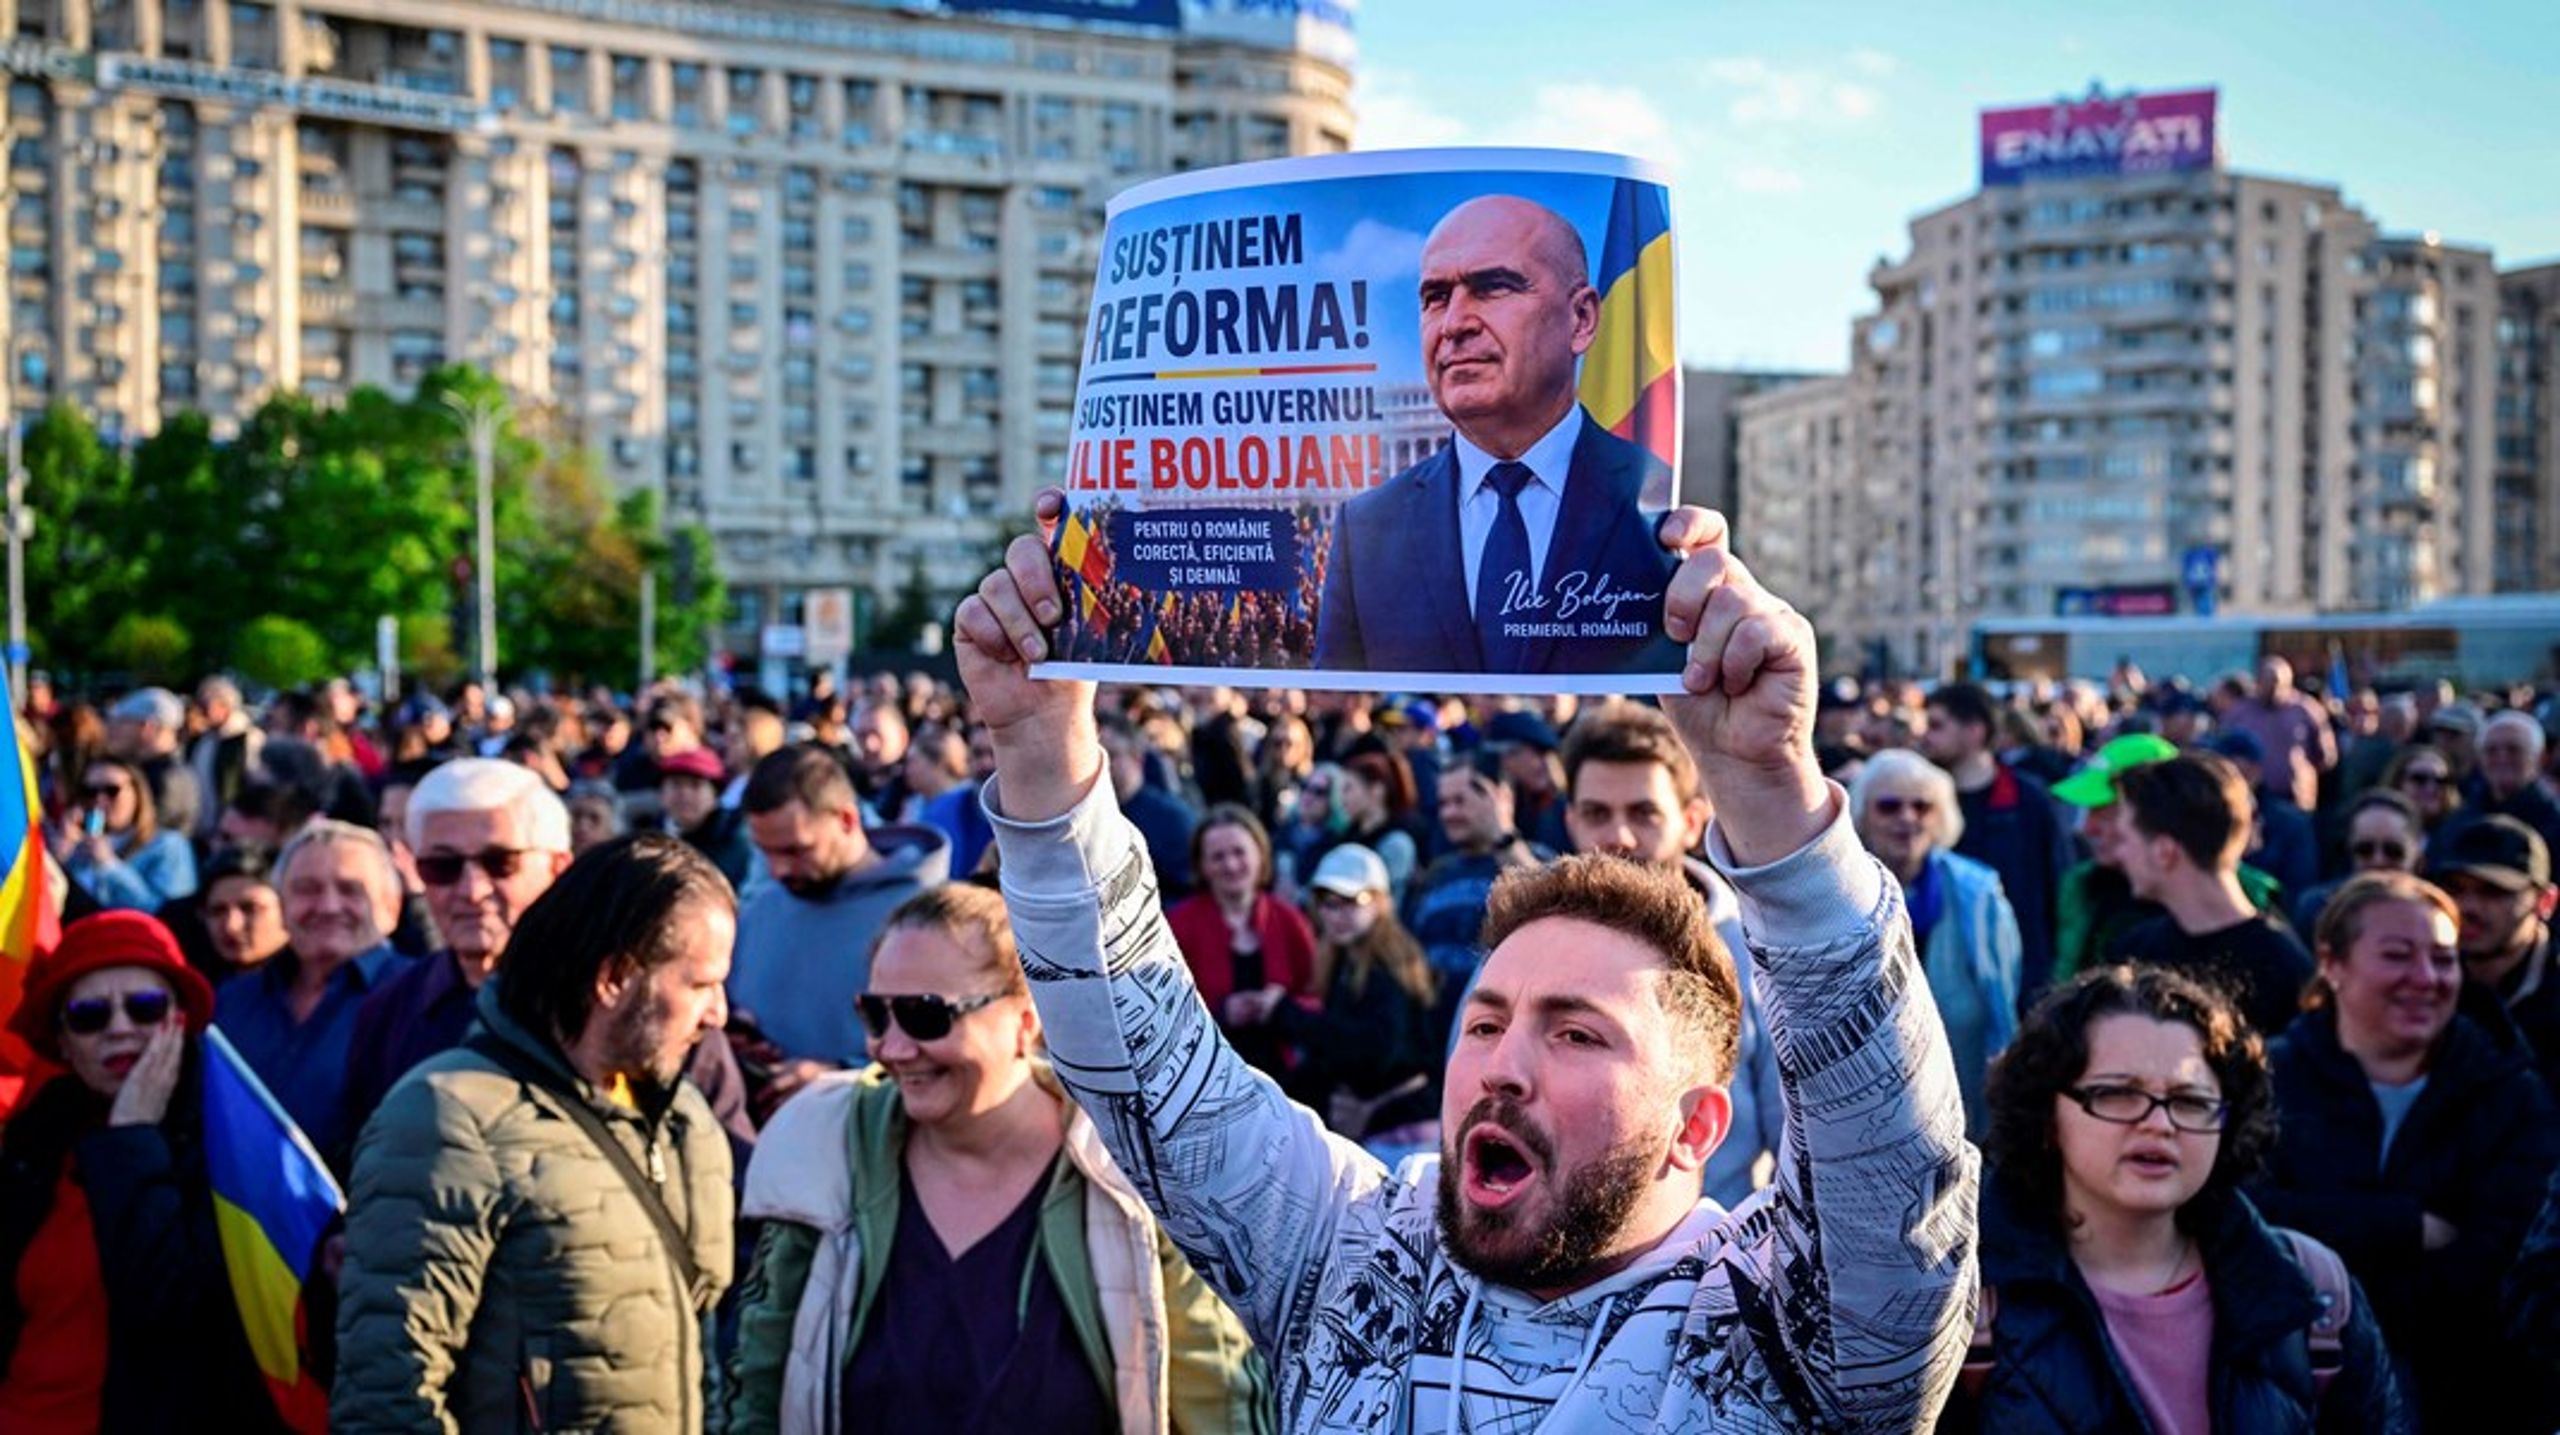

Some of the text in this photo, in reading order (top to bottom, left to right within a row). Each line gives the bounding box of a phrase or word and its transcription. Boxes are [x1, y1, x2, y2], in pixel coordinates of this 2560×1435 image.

[1995, 114, 2201, 167] ENAYATI
[1110, 213, 1303, 287] SUSȚINEM
[1091, 280, 1370, 366] REFORMA!
[1078, 386, 1383, 435] SUSȚINEM GUVERNUL
[1069, 434, 1383, 490] ILIE BOLOJAN!
[1133, 518, 1272, 539] PENTRU O ROMÂNIE
[1133, 541, 1276, 563] CORECTĂ, EFICIENTĂ
[1169, 564, 1241, 587] ȘI DEMNĂ!
[1499, 569, 1660, 621] Ilie Bolojan
[1504, 619, 1648, 638] PREMIERUL ROMÂNIEI
